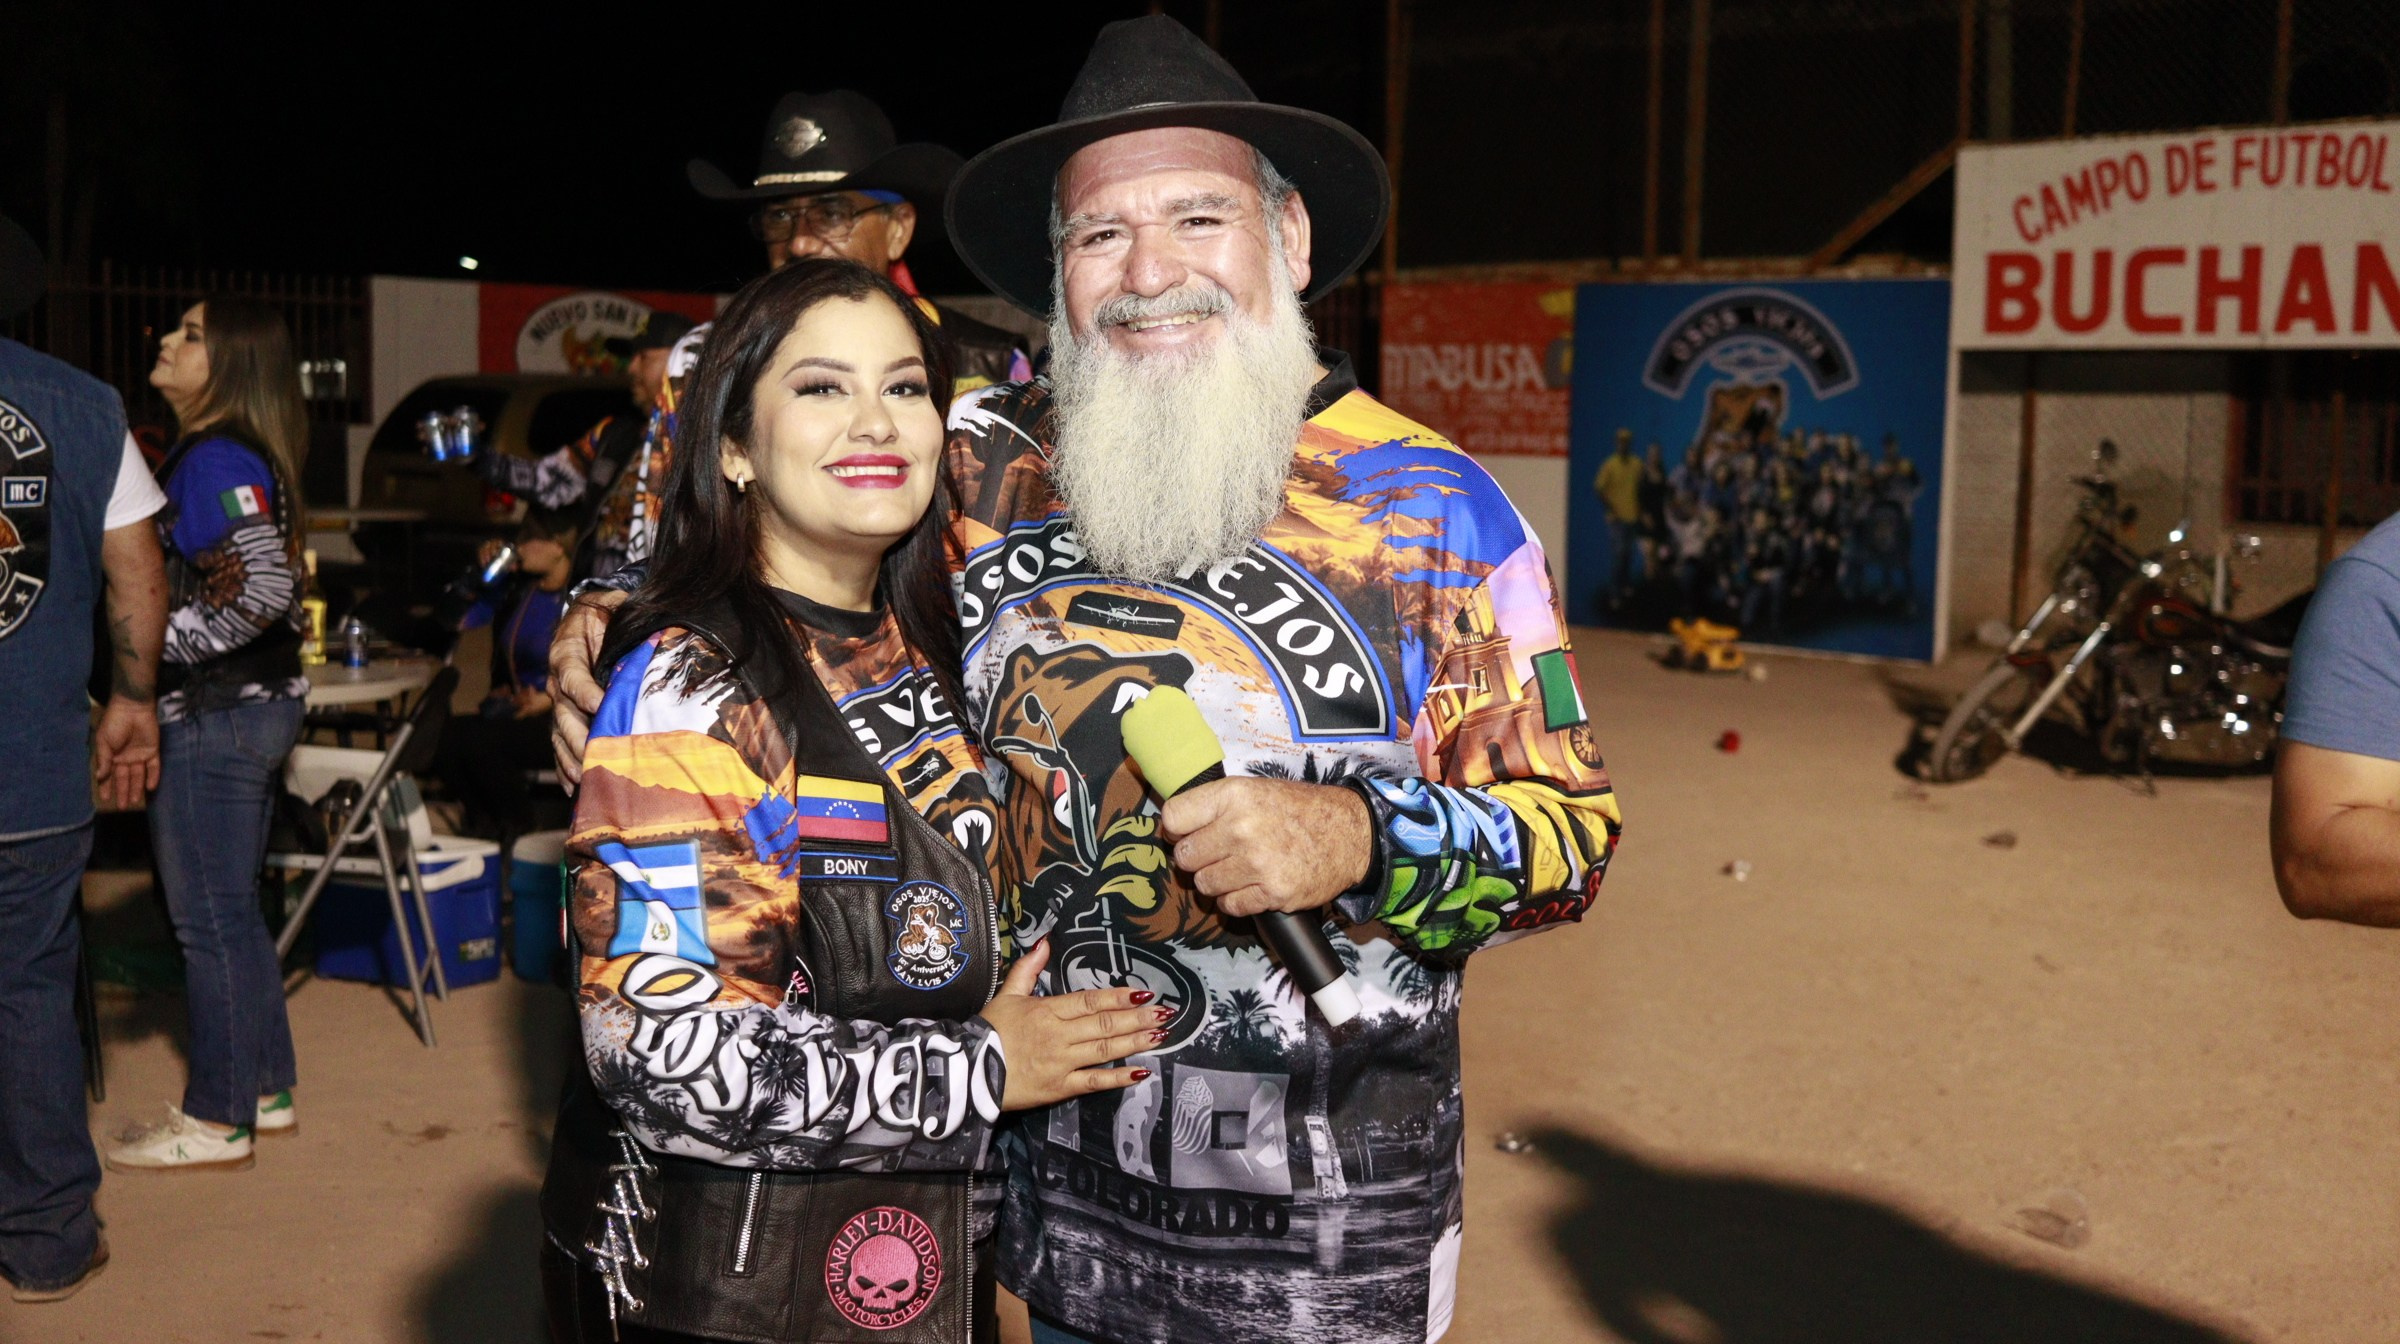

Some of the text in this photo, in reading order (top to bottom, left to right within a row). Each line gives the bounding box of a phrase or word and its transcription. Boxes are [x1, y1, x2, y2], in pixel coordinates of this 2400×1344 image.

[2013, 132, 2393, 244] CAMPO DE FUTBOL
[1984, 243, 2400, 335] BUCHAN
[0, 407, 31, 443] OS
[823, 859, 869, 876] BONY
[891, 889, 914, 912] OSOS
[949, 918, 963, 929] MC
[894, 964, 915, 985] SAN
[910, 958, 956, 975] Aniversario
[1037, 1151, 1290, 1239] COLORADO
[828, 1210, 937, 1290] HARLEY-DAVIDSON
[835, 1288, 925, 1326] MOTORCYCLES
